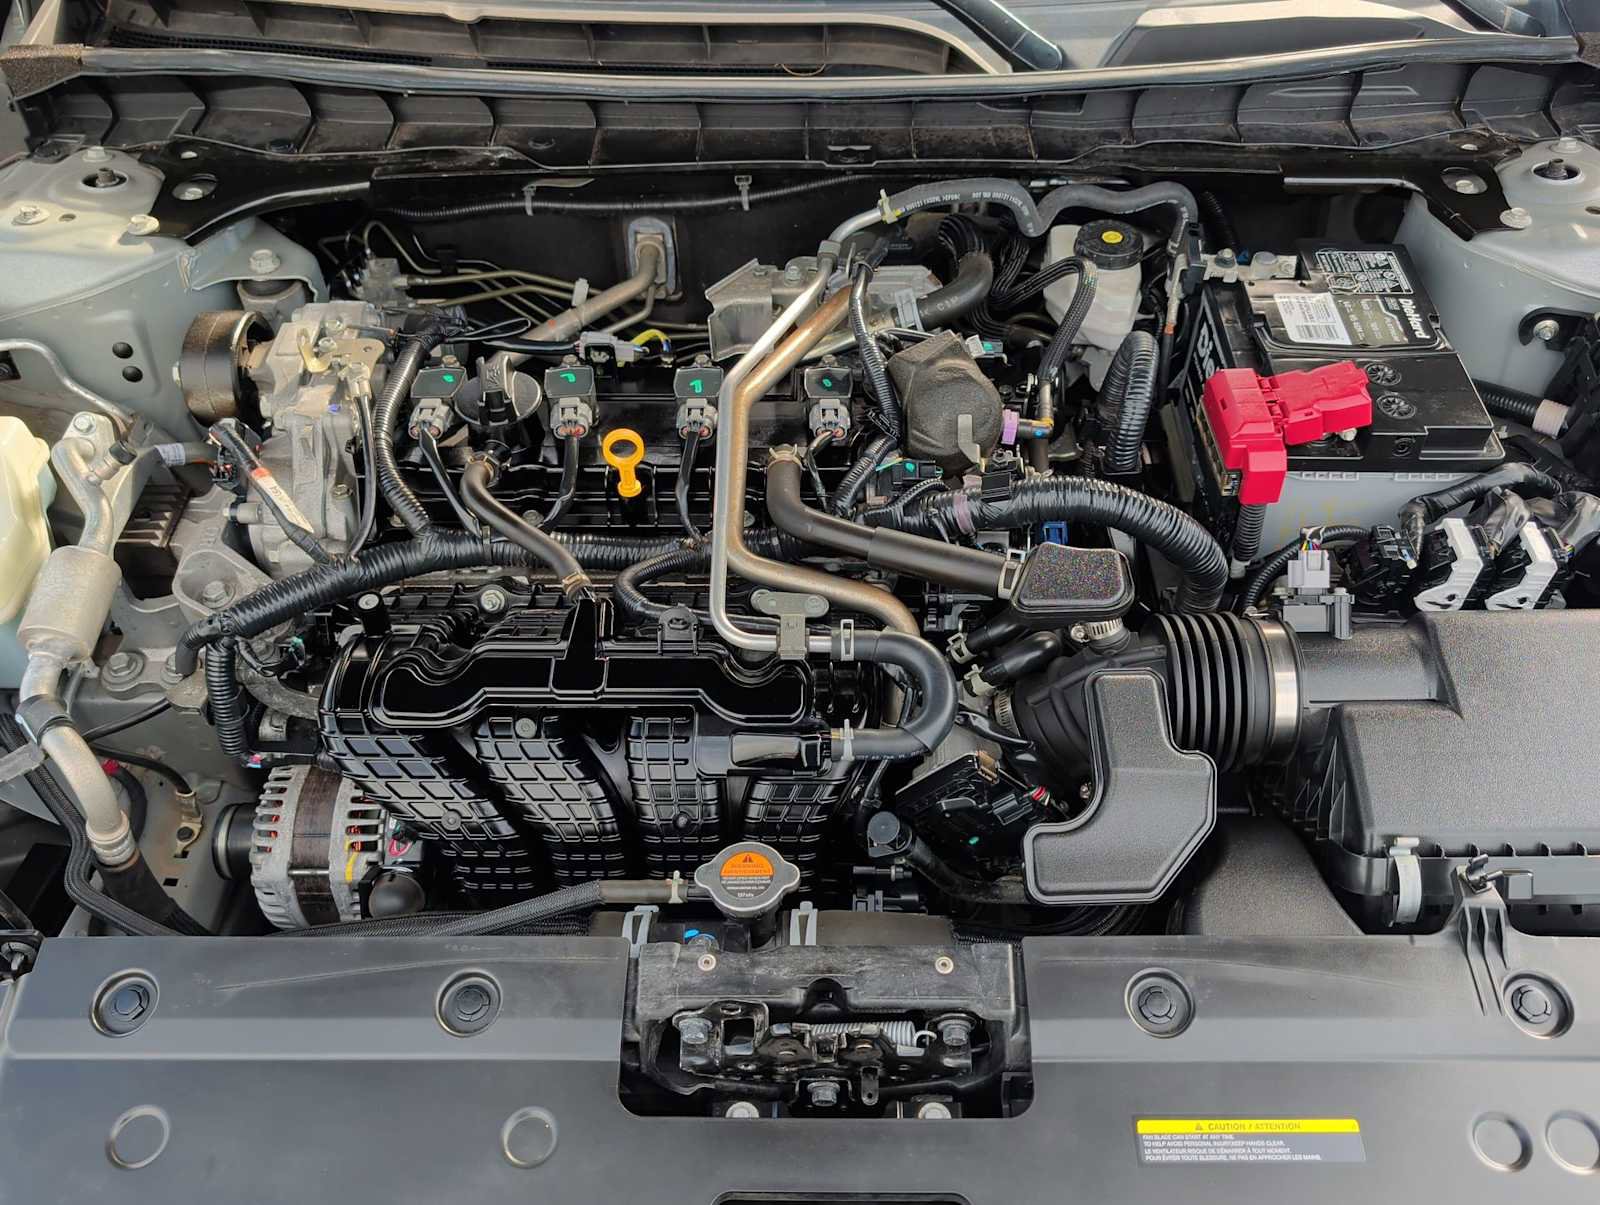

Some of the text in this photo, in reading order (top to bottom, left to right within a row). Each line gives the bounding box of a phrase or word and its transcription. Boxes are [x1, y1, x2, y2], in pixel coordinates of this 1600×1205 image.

[1398, 298, 1431, 339] DieHard
[1197, 322, 1218, 379] Die
[1208, 1122, 1246, 1131] CAUTION
[1255, 1122, 1301, 1130] ATTENTION
